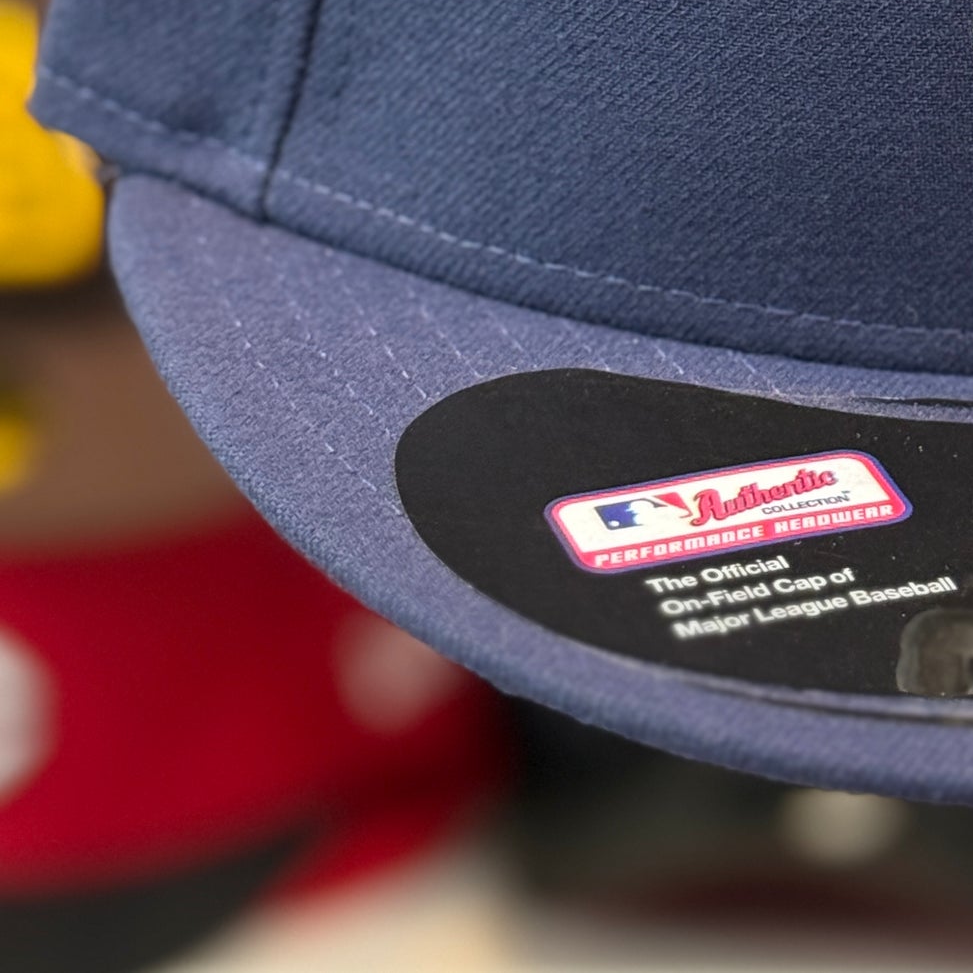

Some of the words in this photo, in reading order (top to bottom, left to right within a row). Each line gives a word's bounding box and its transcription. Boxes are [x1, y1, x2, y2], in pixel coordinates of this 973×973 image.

[690, 469, 838, 527] Authentic
[594, 525, 766, 566] PERFORMANCE
[774, 504, 894, 534] HEADWEAR
[646, 575, 699, 593] The
[700, 555, 790, 583] Official
[660, 583, 771, 615] On-Field
[773, 574, 827, 591] Cap
[829, 567, 856, 584] of
[673, 611, 751, 638] Major
[754, 593, 849, 623] League
[850, 576, 958, 605] Baseball
